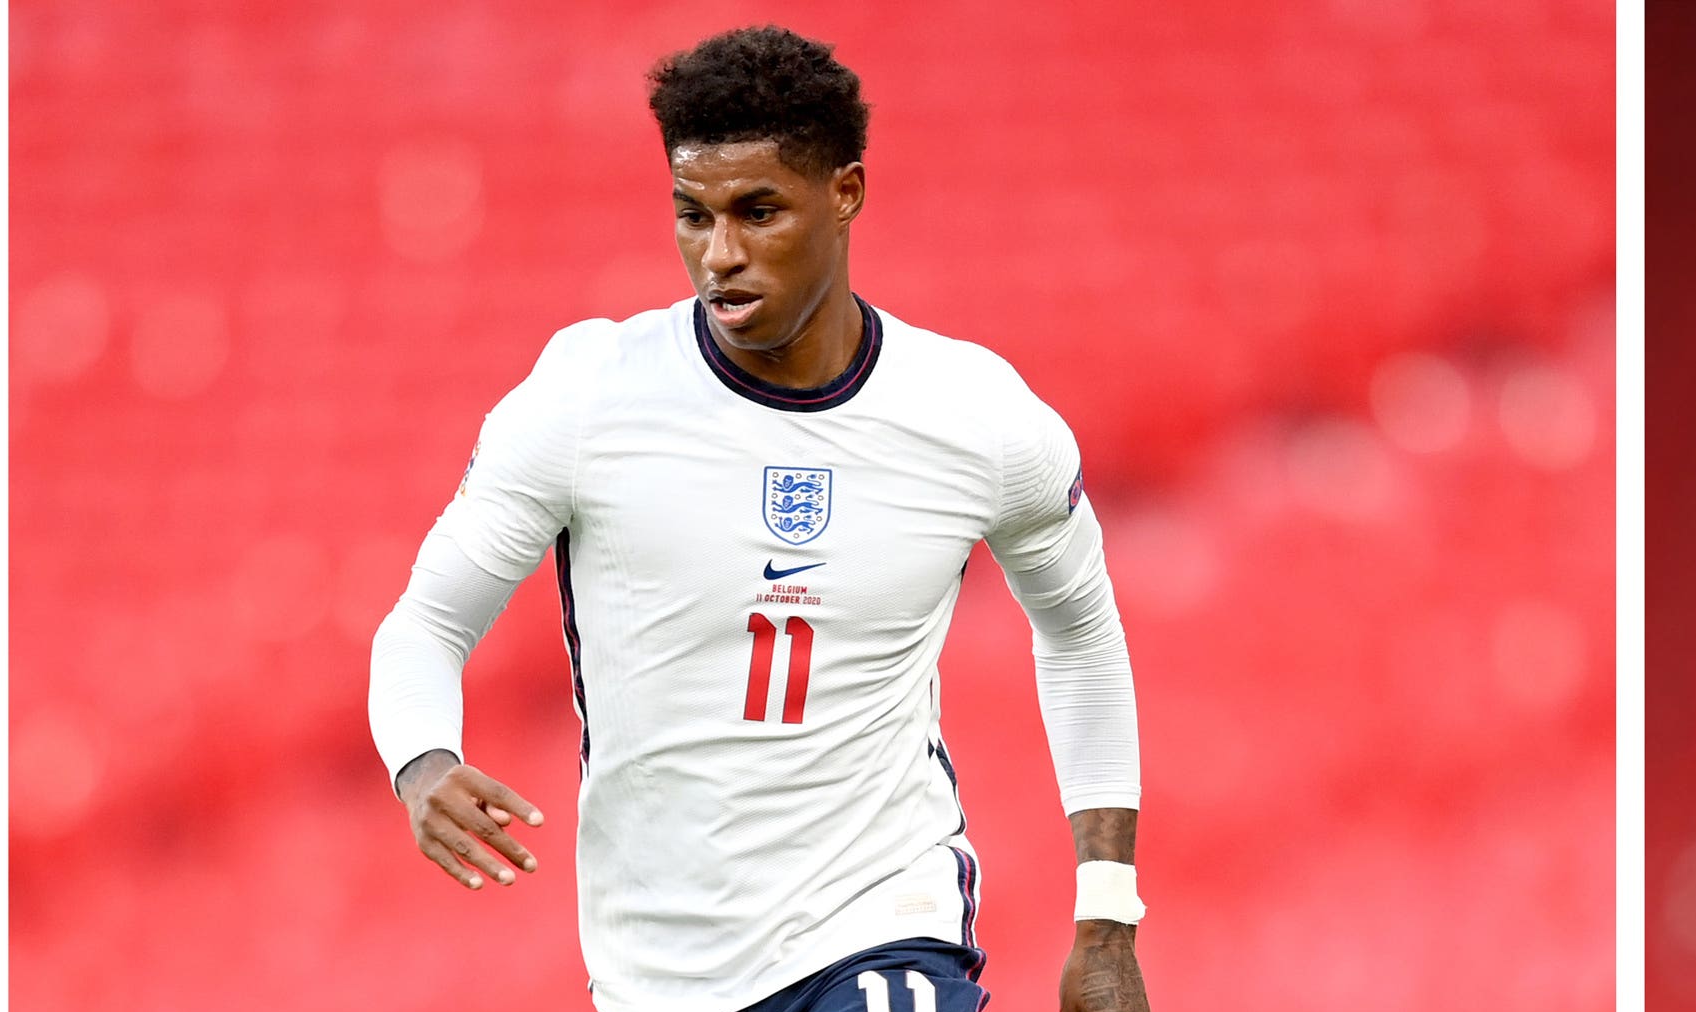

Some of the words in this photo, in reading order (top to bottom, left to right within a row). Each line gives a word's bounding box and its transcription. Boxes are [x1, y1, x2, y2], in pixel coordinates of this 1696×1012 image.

[772, 584, 807, 594] BELGIUM
[756, 593, 762, 602] 11
[764, 594, 800, 604] OCTOBER
[803, 595, 821, 605] 2020
[743, 612, 814, 724] 11
